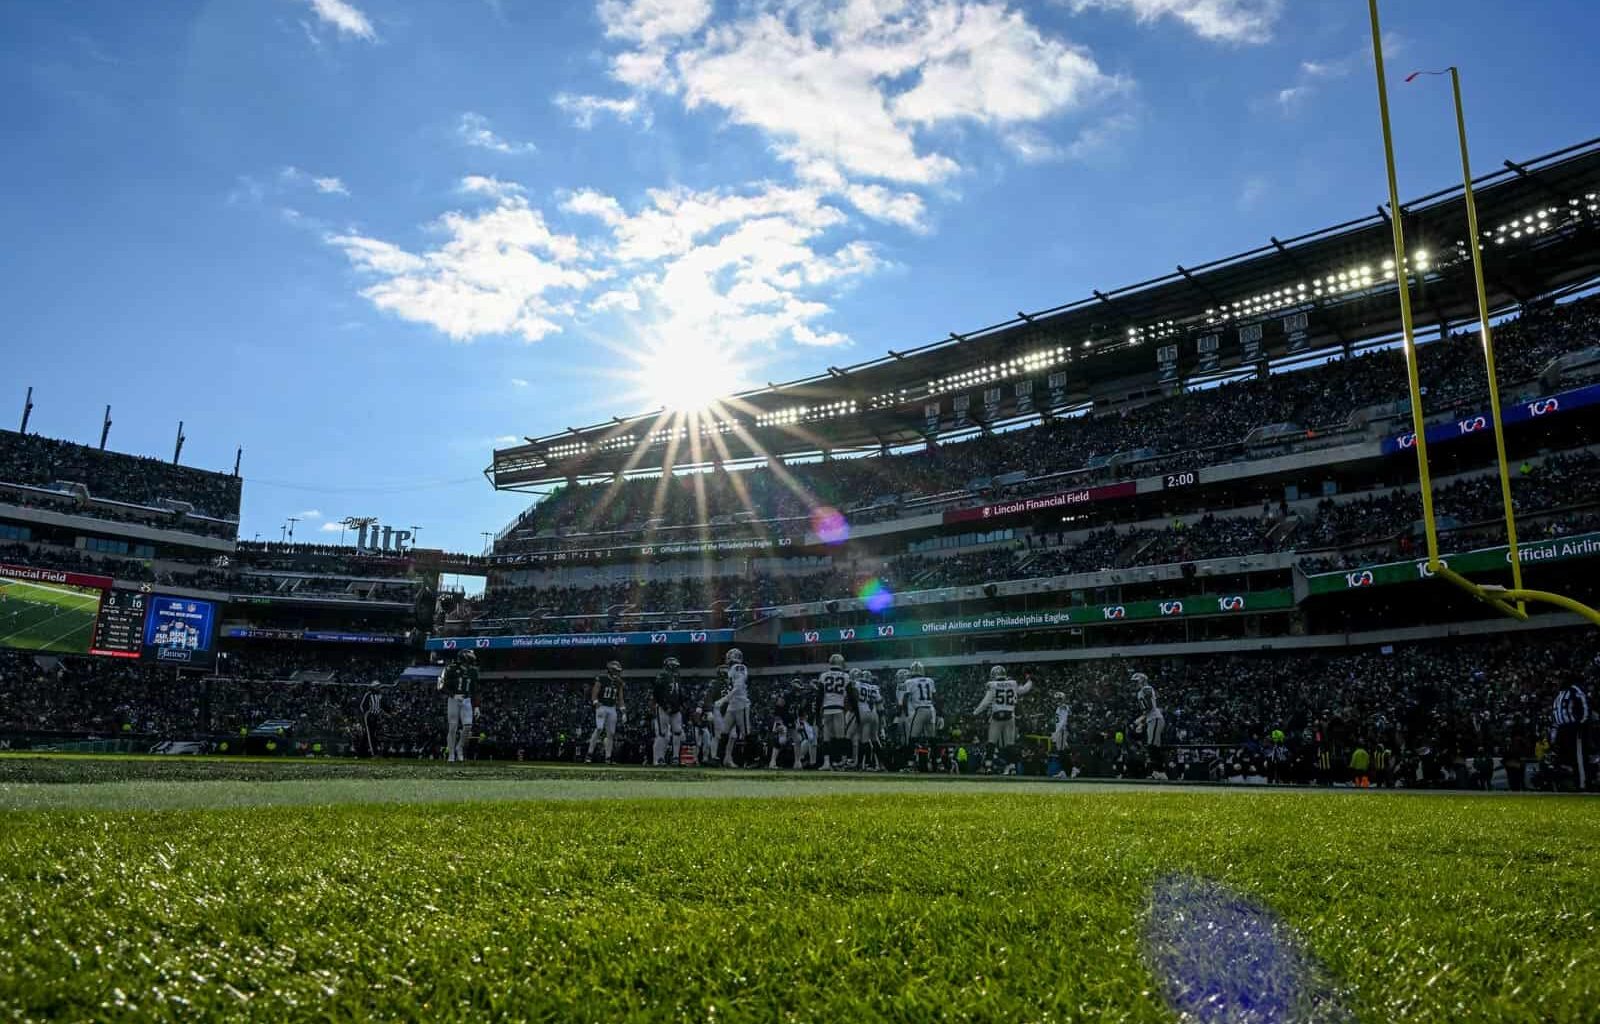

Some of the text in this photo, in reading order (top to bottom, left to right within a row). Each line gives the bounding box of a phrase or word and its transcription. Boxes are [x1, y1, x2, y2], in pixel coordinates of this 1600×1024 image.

[1528, 398, 1559, 417] 100
[1458, 416, 1486, 434] 100
[1167, 473, 1194, 488] 2:00
[993, 491, 1090, 516] Lincoln Financial Field
[41, 571, 67, 582] Field
[1345, 570, 1374, 588] 100
[1103, 606, 1125, 619] 100
[1159, 601, 1183, 615] 100
[1218, 596, 1244, 612] 100
[922, 611, 1070, 632] Official Airline of the Philadelphia Eagles
[824, 676, 845, 694] 22
